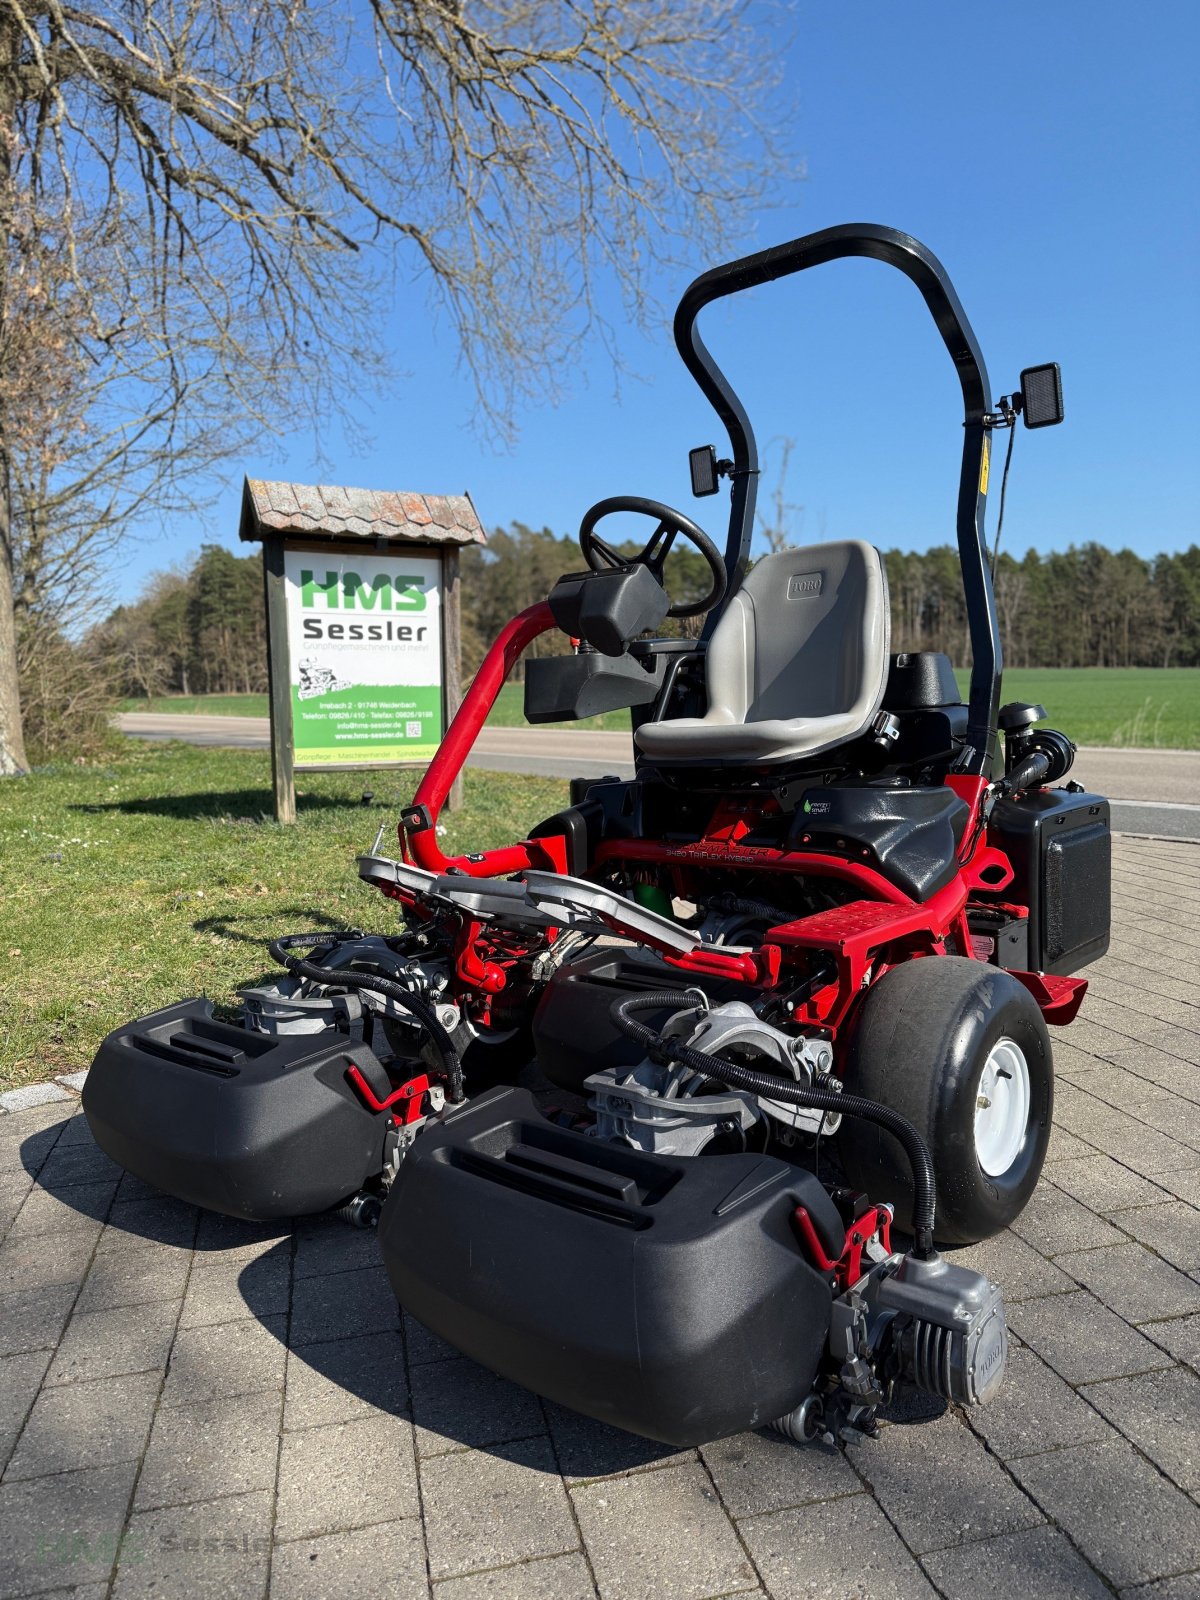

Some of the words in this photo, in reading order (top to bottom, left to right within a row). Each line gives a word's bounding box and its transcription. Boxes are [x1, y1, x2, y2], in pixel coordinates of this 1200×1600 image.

[300, 569, 427, 612] HMS
[792, 580, 822, 592] TORO
[303, 618, 428, 642] Sessler
[302, 712, 329, 720] Telefon:
[337, 721, 402, 730] info@hms-sessler.de
[335, 731, 404, 740] www.hms-sessler.de
[665, 849, 687, 858] 3420
